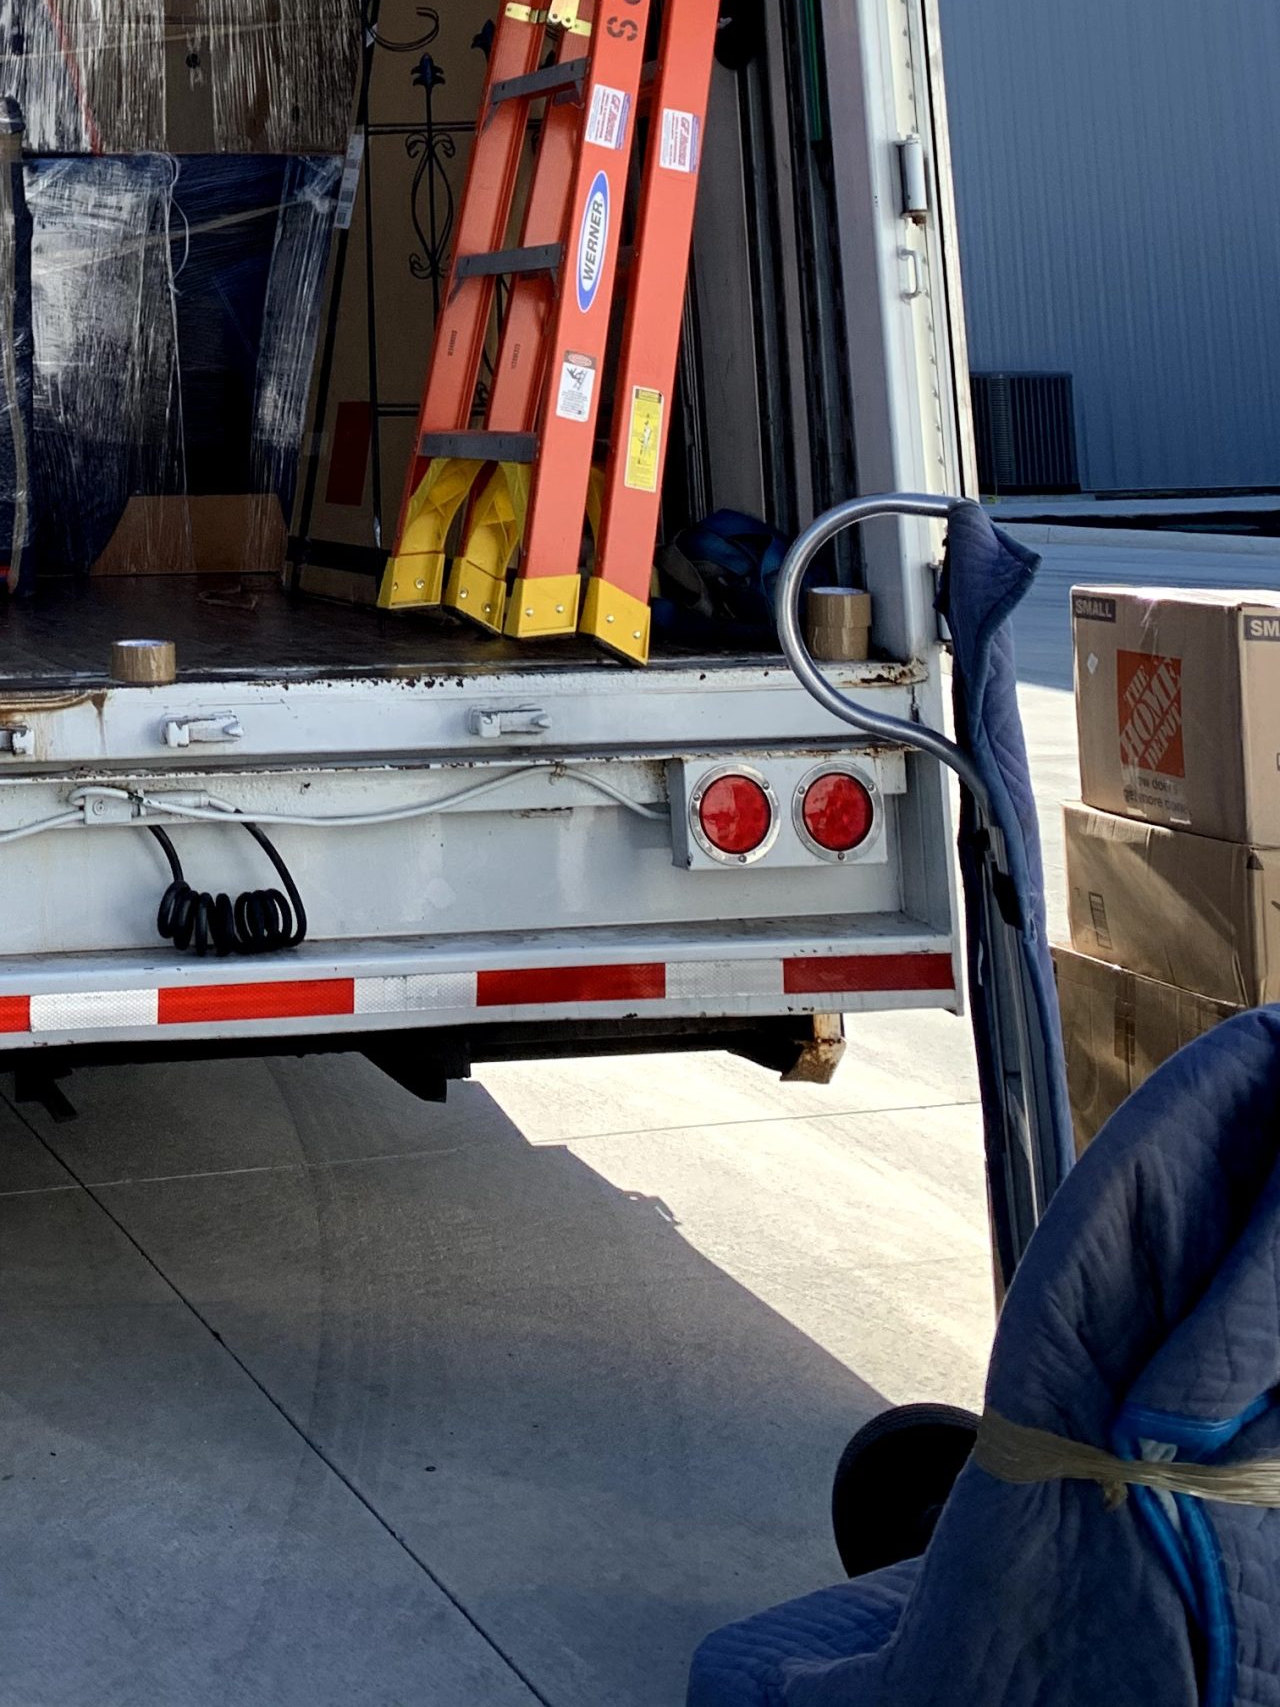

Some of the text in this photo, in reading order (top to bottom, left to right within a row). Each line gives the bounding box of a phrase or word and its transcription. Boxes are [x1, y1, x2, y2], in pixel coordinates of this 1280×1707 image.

[582, 200, 604, 282] WERNER
[1074, 600, 1114, 619] SMALL
[1250, 619, 1280, 637] SM
[1120, 658, 1181, 759] HOME
[1123, 664, 1150, 709] THE
[1144, 701, 1181, 772] DEPOT
